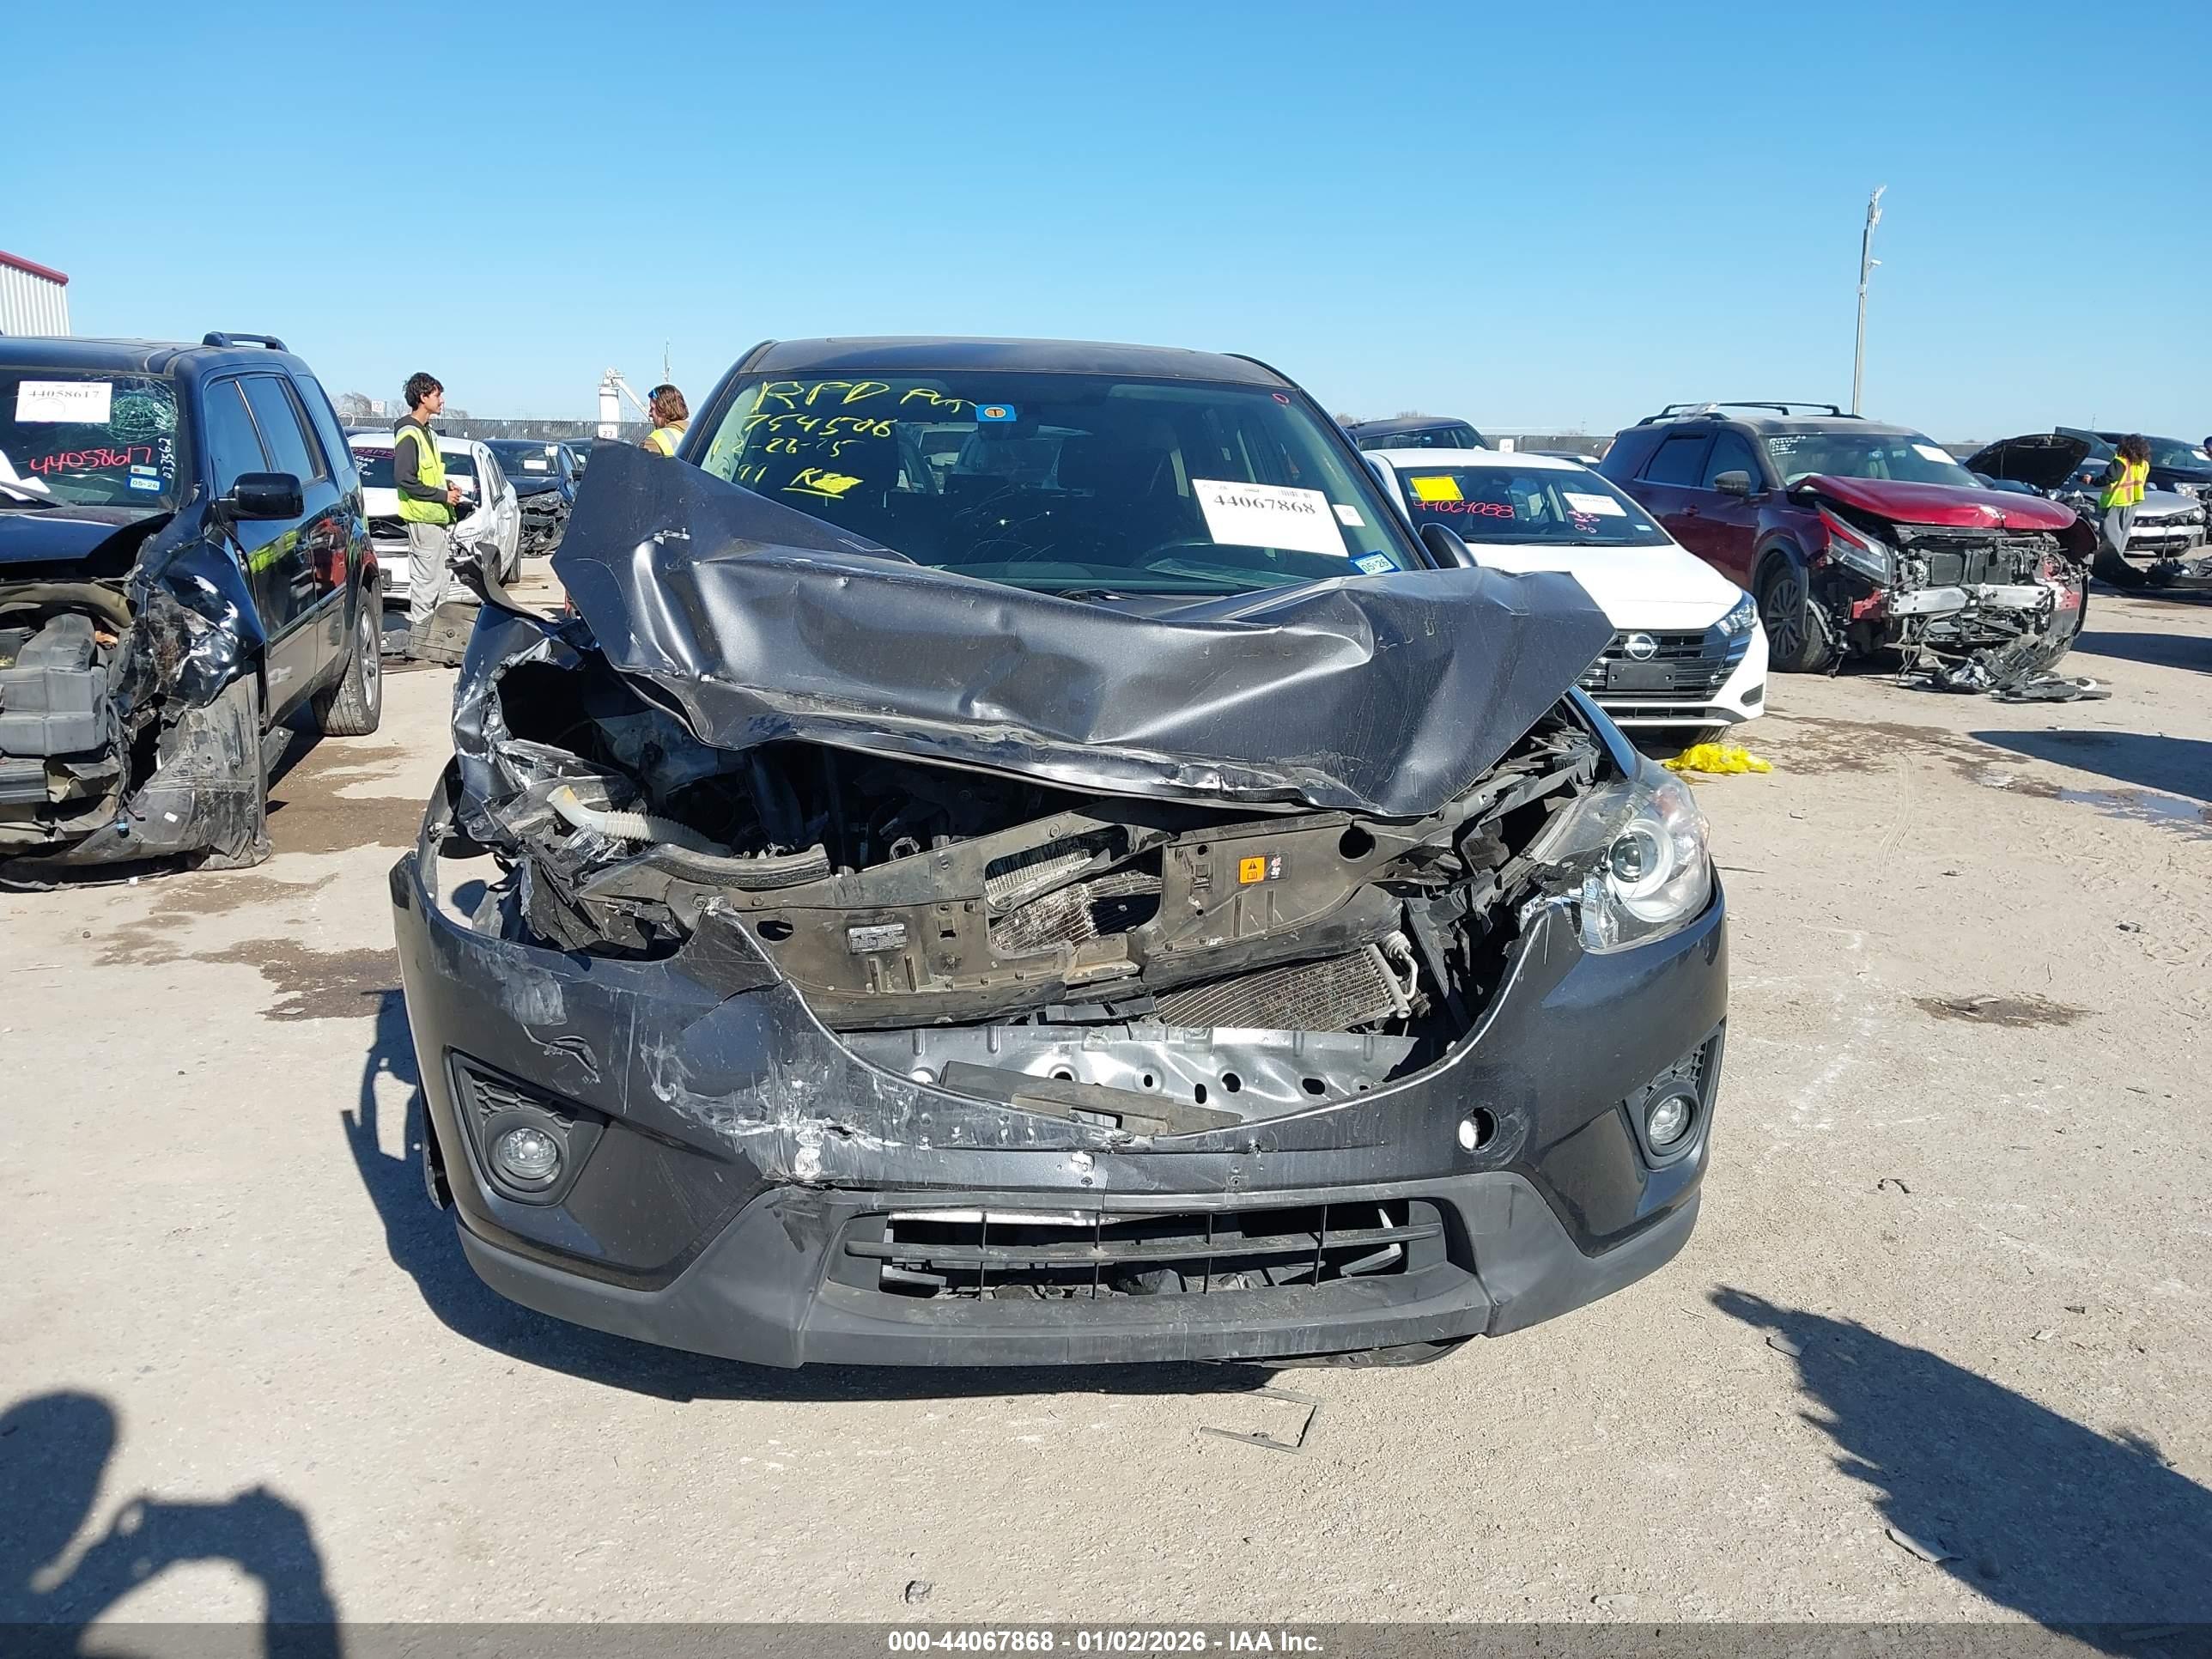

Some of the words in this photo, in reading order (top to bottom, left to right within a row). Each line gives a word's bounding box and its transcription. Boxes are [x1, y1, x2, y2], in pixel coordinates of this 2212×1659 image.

[27, 389, 100, 398] 44058617
[750, 380, 890, 412] RPD
[29, 447, 152, 475] 44058617
[1213, 494, 1316, 514] 44067868
[1413, 501, 1515, 518] 44064088
